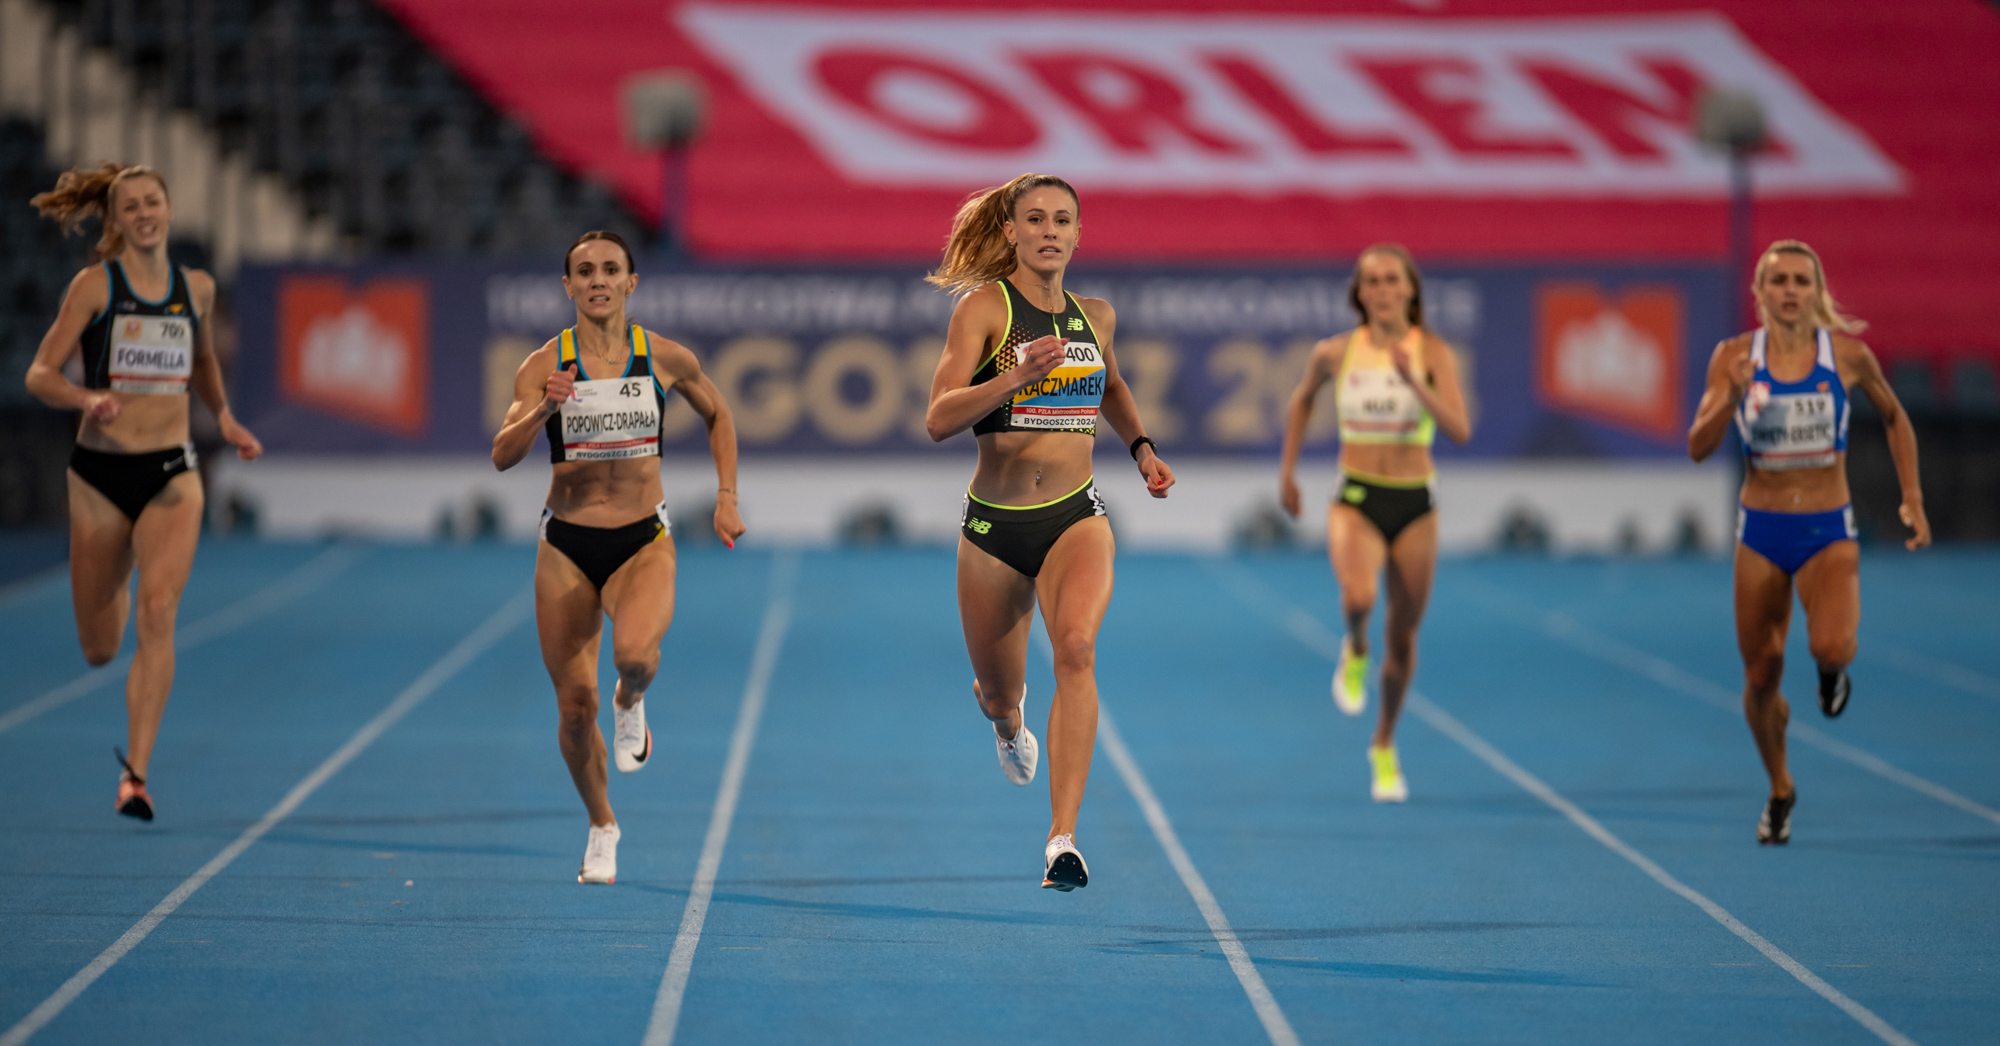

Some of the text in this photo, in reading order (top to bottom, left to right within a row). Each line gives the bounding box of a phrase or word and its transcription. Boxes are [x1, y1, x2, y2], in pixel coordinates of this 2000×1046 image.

[810, 46, 1796, 163] ORLEN
[117, 347, 185, 370] FORMELLA
[619, 382, 641, 398] 45
[566, 410, 656, 434] POPOWICZ-DRAPAŁA
[1024, 417, 1095, 426] BYDGOSZCZ 2024
[576, 447, 648, 459] BYDGOSZCZ 2024
